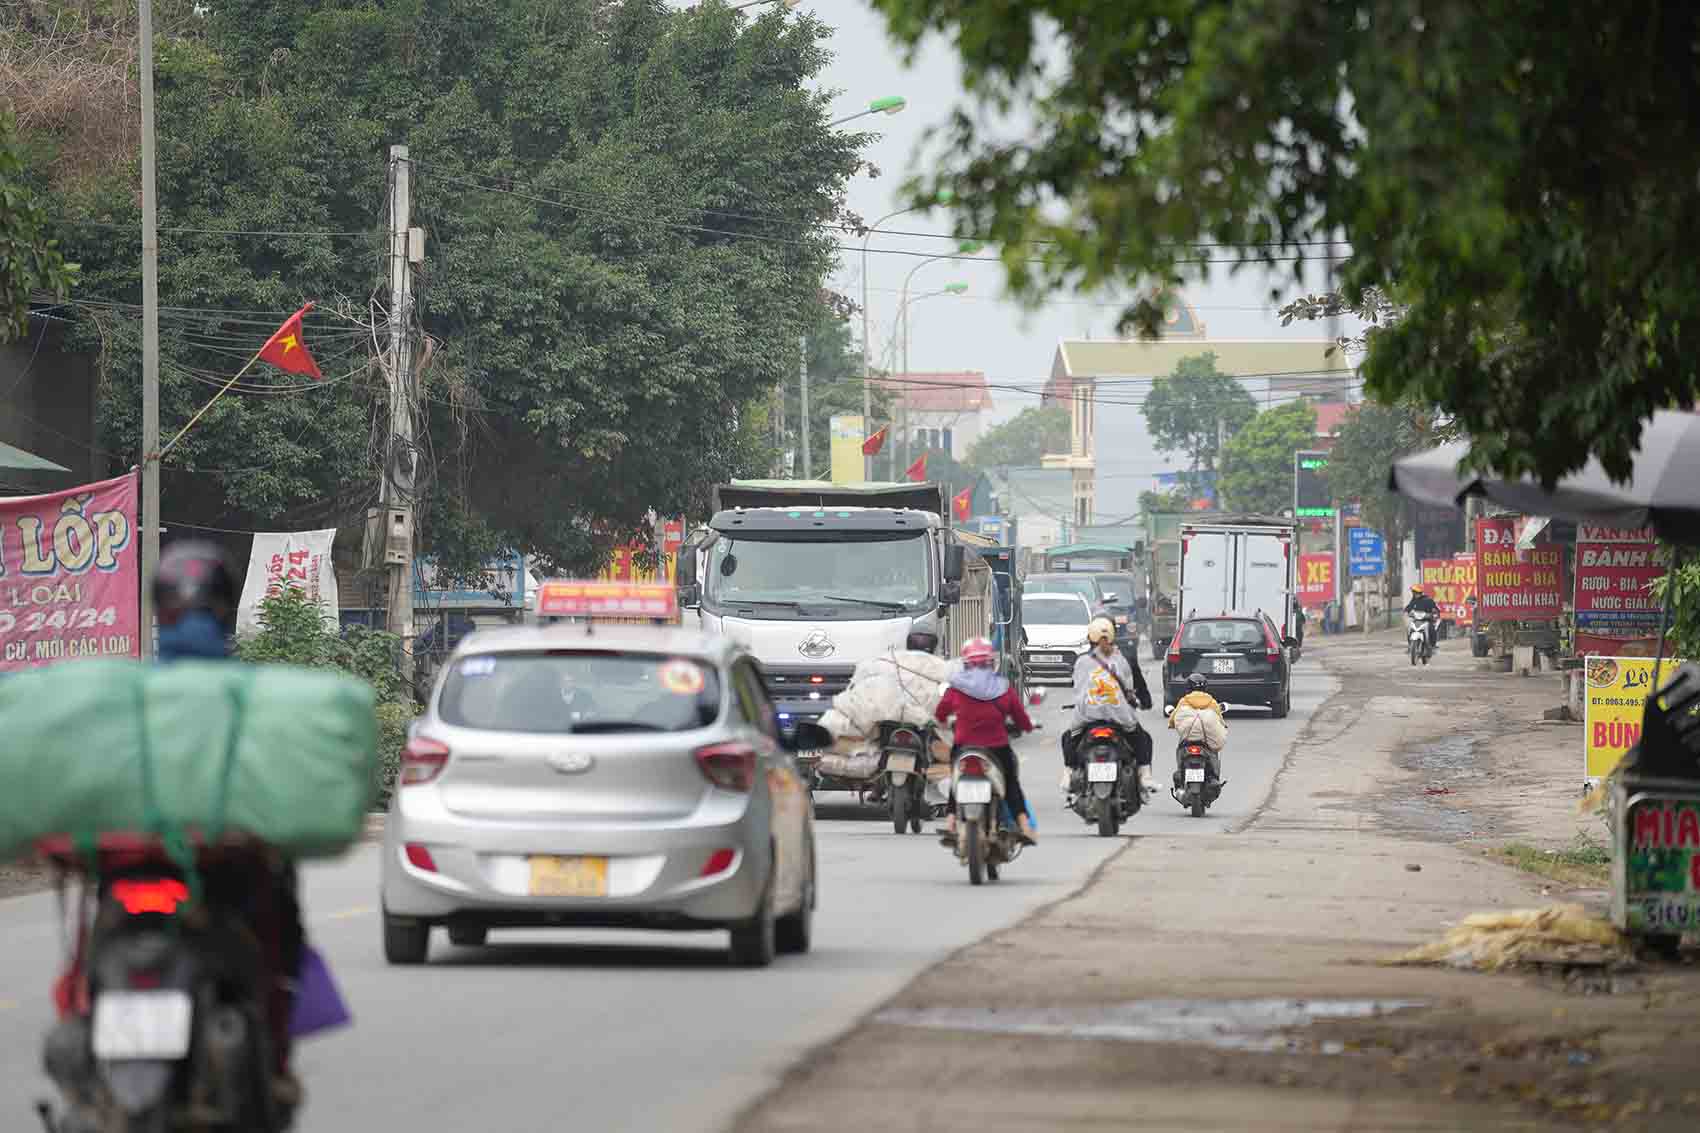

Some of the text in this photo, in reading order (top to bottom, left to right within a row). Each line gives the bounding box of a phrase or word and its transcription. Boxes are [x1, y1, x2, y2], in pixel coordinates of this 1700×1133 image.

[16, 491, 131, 576] LỐP
[1306, 560, 1332, 583] XE
[24, 605, 117, 631] 24/24
[1593, 717, 1640, 748] BÚN
